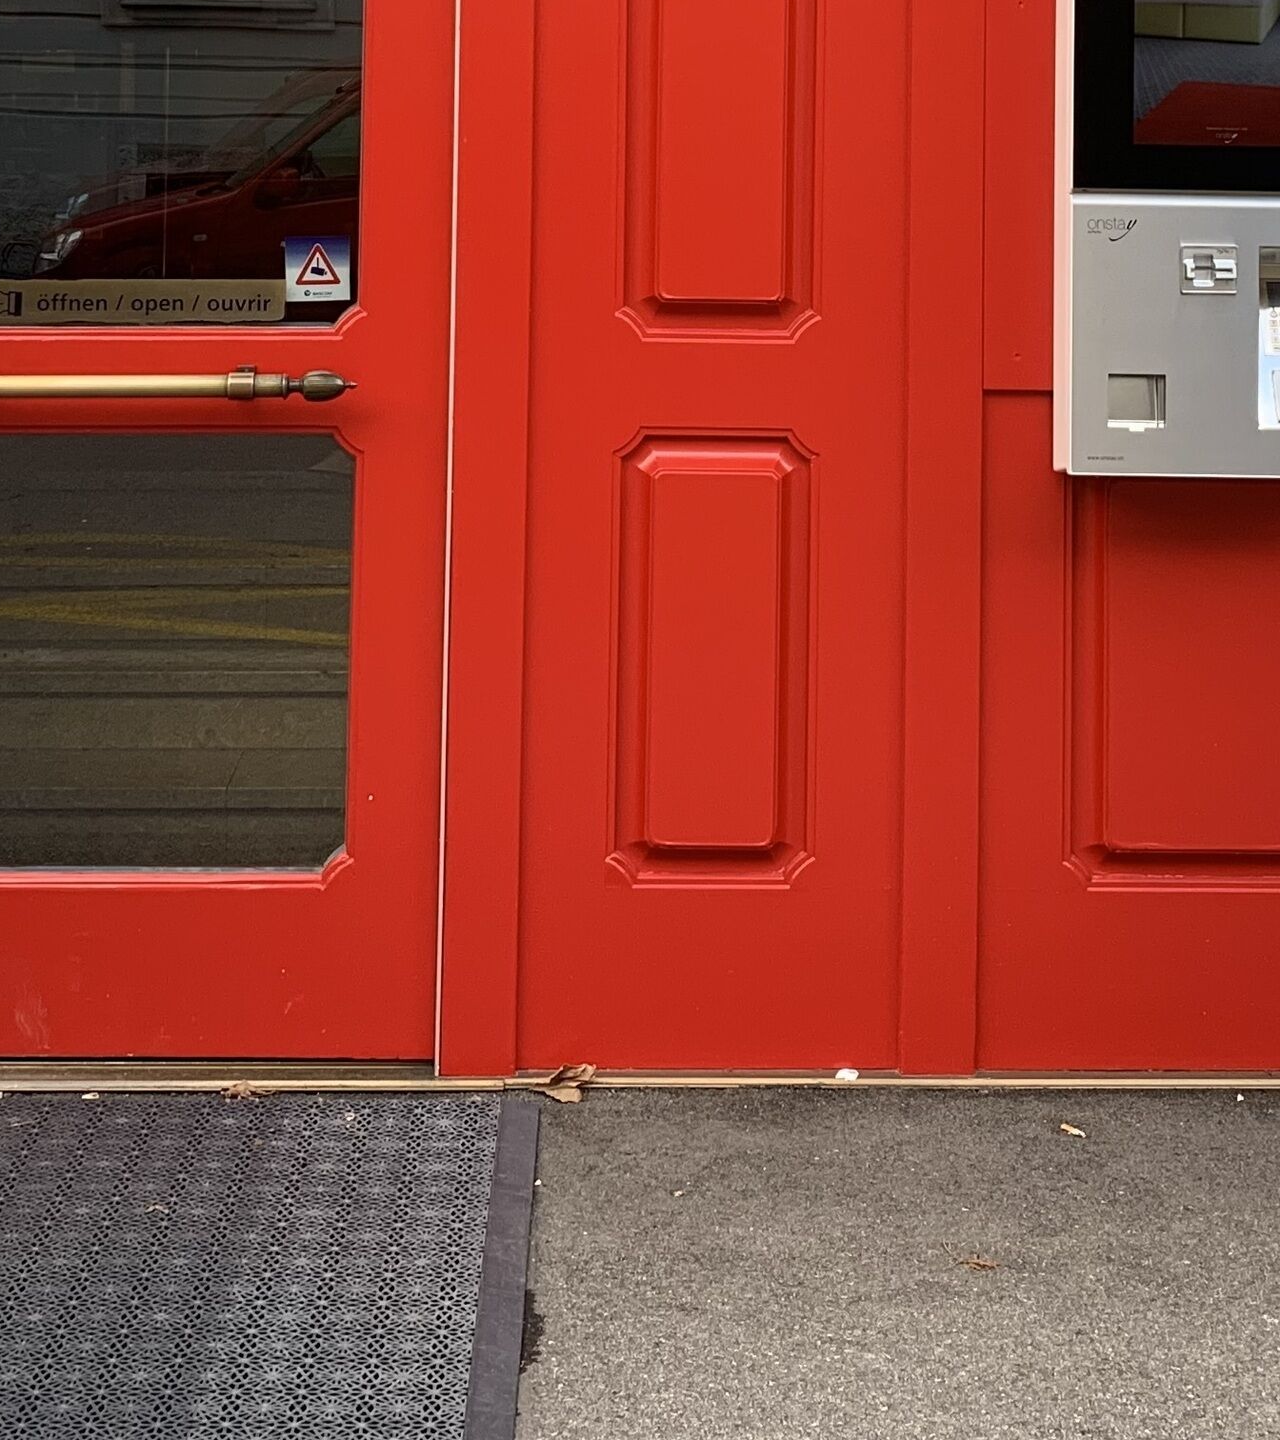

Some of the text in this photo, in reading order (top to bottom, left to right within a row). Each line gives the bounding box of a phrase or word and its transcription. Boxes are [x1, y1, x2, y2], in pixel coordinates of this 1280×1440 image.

[1087, 218, 1137, 241] onstay
[36, 293, 108, 312] öffnen
[130, 296, 184, 316] open
[207, 294, 271, 312] ouvrir
